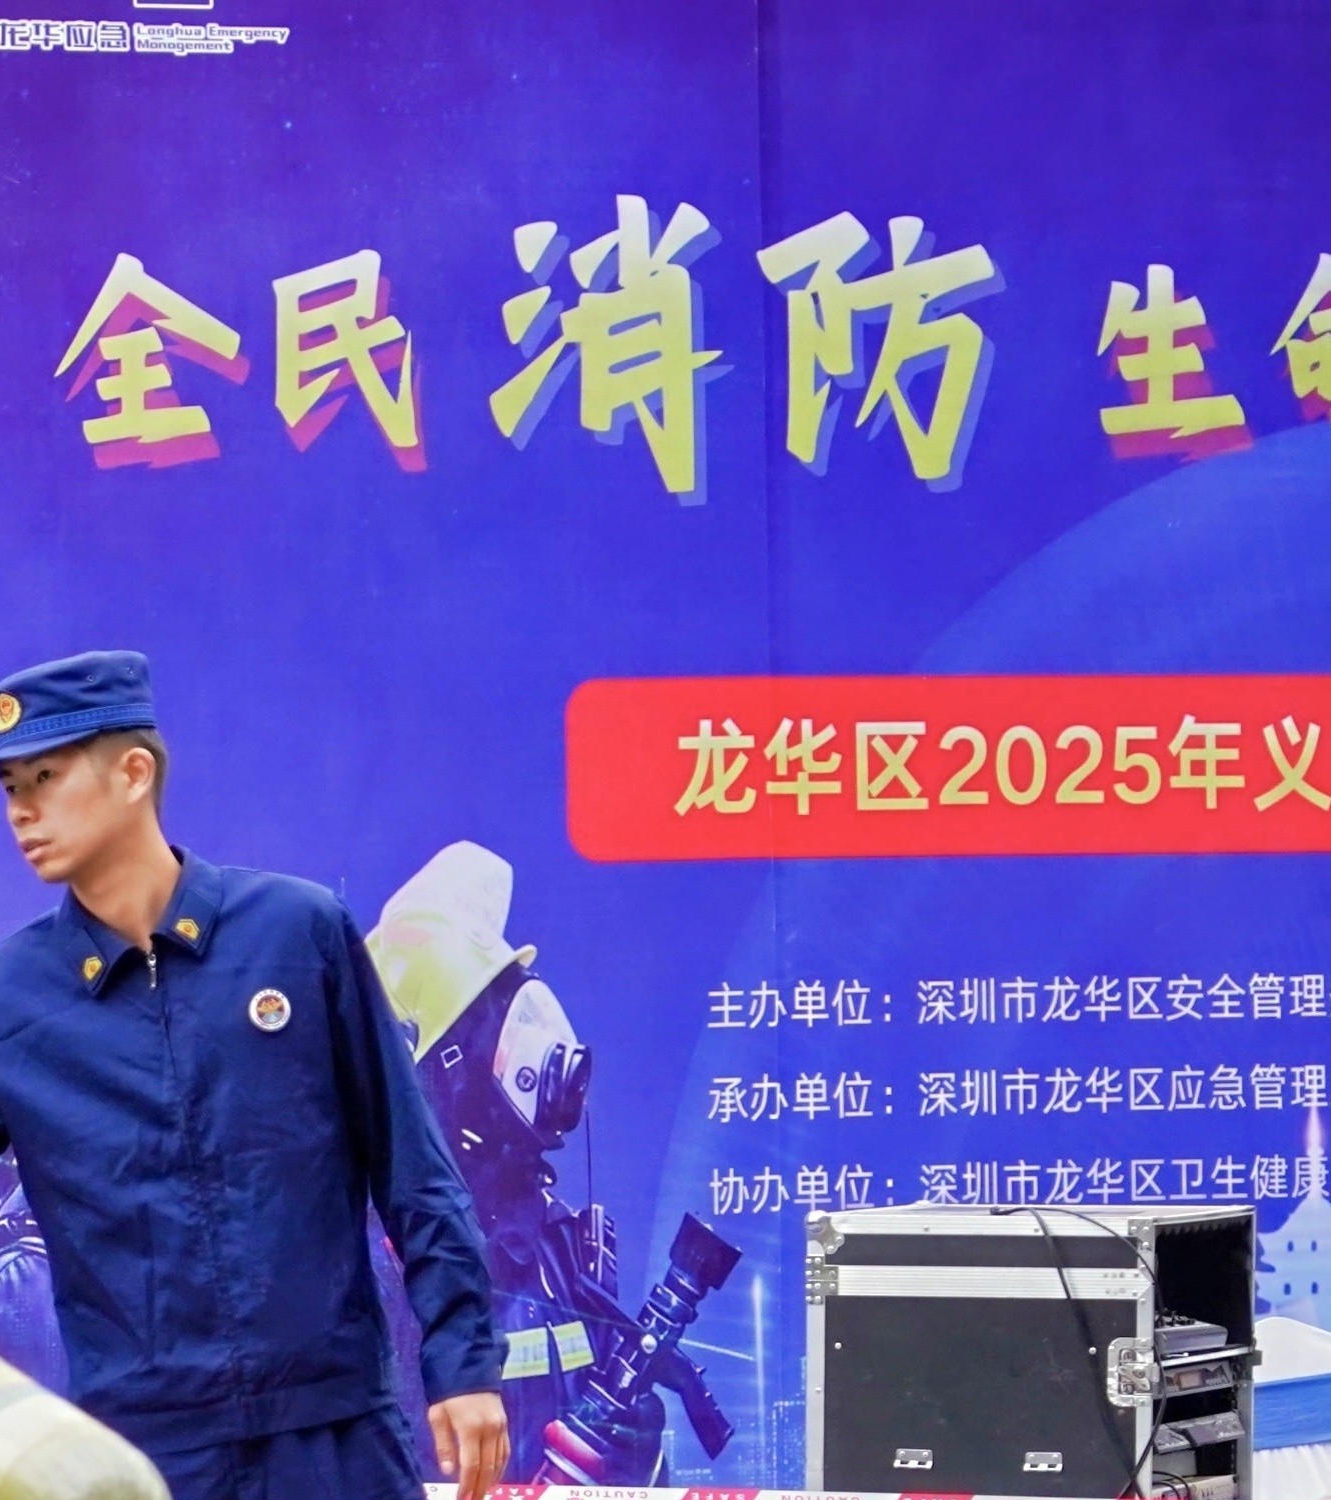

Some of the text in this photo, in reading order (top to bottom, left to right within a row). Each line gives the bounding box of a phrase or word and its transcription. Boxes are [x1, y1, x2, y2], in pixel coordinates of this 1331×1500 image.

[136, 24, 289, 42] Longhua Emergency
[136, 39, 233, 53] Management
[54, 194, 995, 494] 全民消防
[674, 715, 1331, 818] 龙华区2025年义
[707, 973, 1331, 1029] 主办单位：深圳市龙华区安全管理
[494, 1487, 534, 1496] SAF
[569, 1489, 648, 1500] CAUTION
